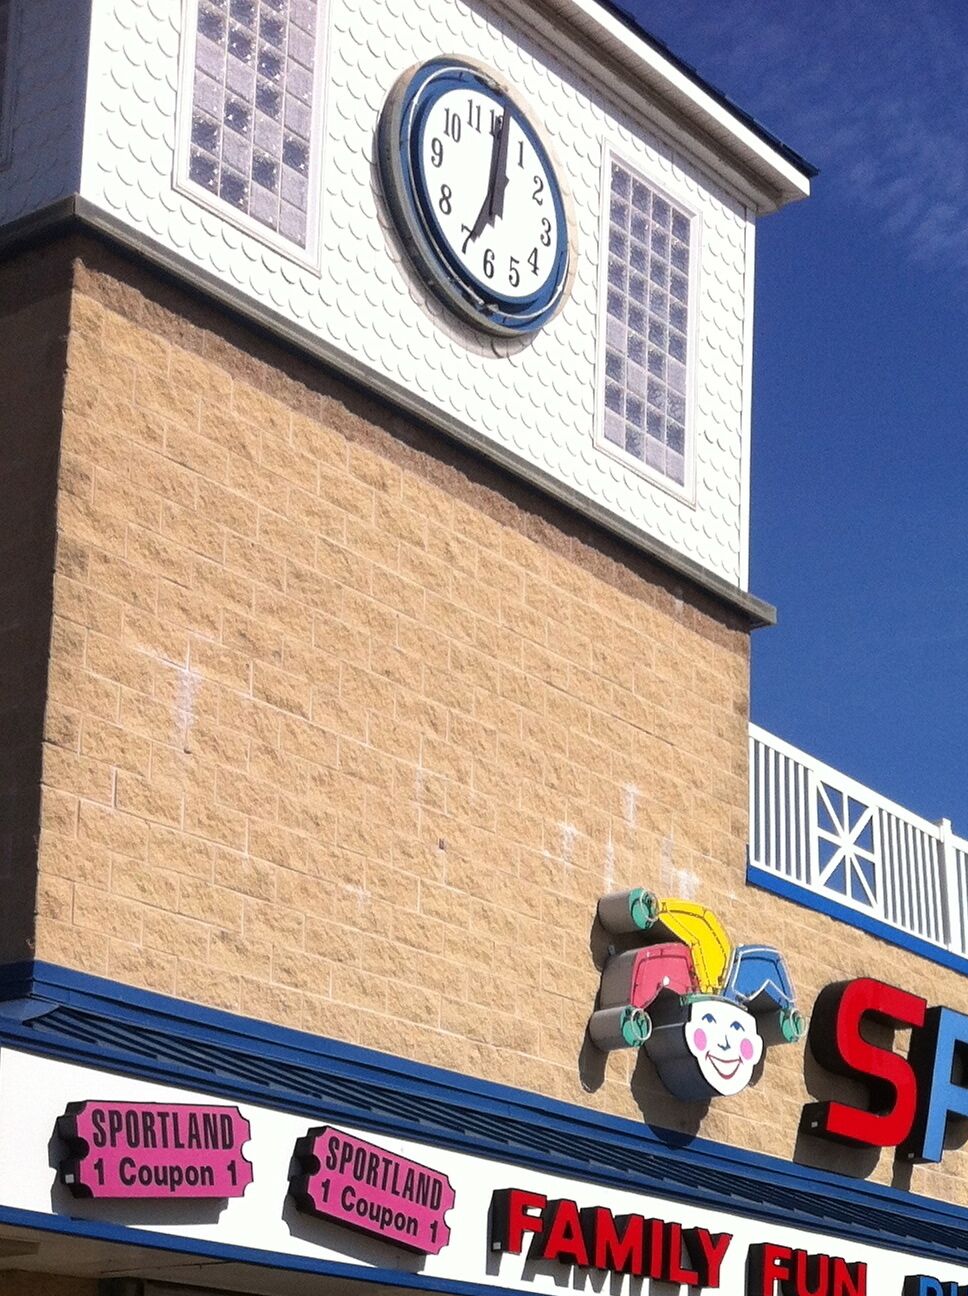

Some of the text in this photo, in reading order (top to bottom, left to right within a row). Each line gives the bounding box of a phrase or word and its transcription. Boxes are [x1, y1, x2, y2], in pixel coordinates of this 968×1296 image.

[443, 107, 462, 143] 10
[466, 99, 482, 133] 11
[430, 137, 444, 168] 9
[516, 140, 525, 169] 1
[438, 184, 453, 215] 8
[531, 175, 545, 206] 2
[540, 217, 552, 248] 3
[482, 248, 496, 279] 6
[508, 256, 521, 288] 5
[527, 247, 540, 277] 4
[91, 1108, 235, 1151] SPORTLAND
[93, 1157, 239, 1192] 1 Coupon 1
[325, 1136, 444, 1212] SPORTLAND
[320, 1178, 440, 1245] 1 Coupon 1
[506, 1187, 733, 1290] FAMILY
